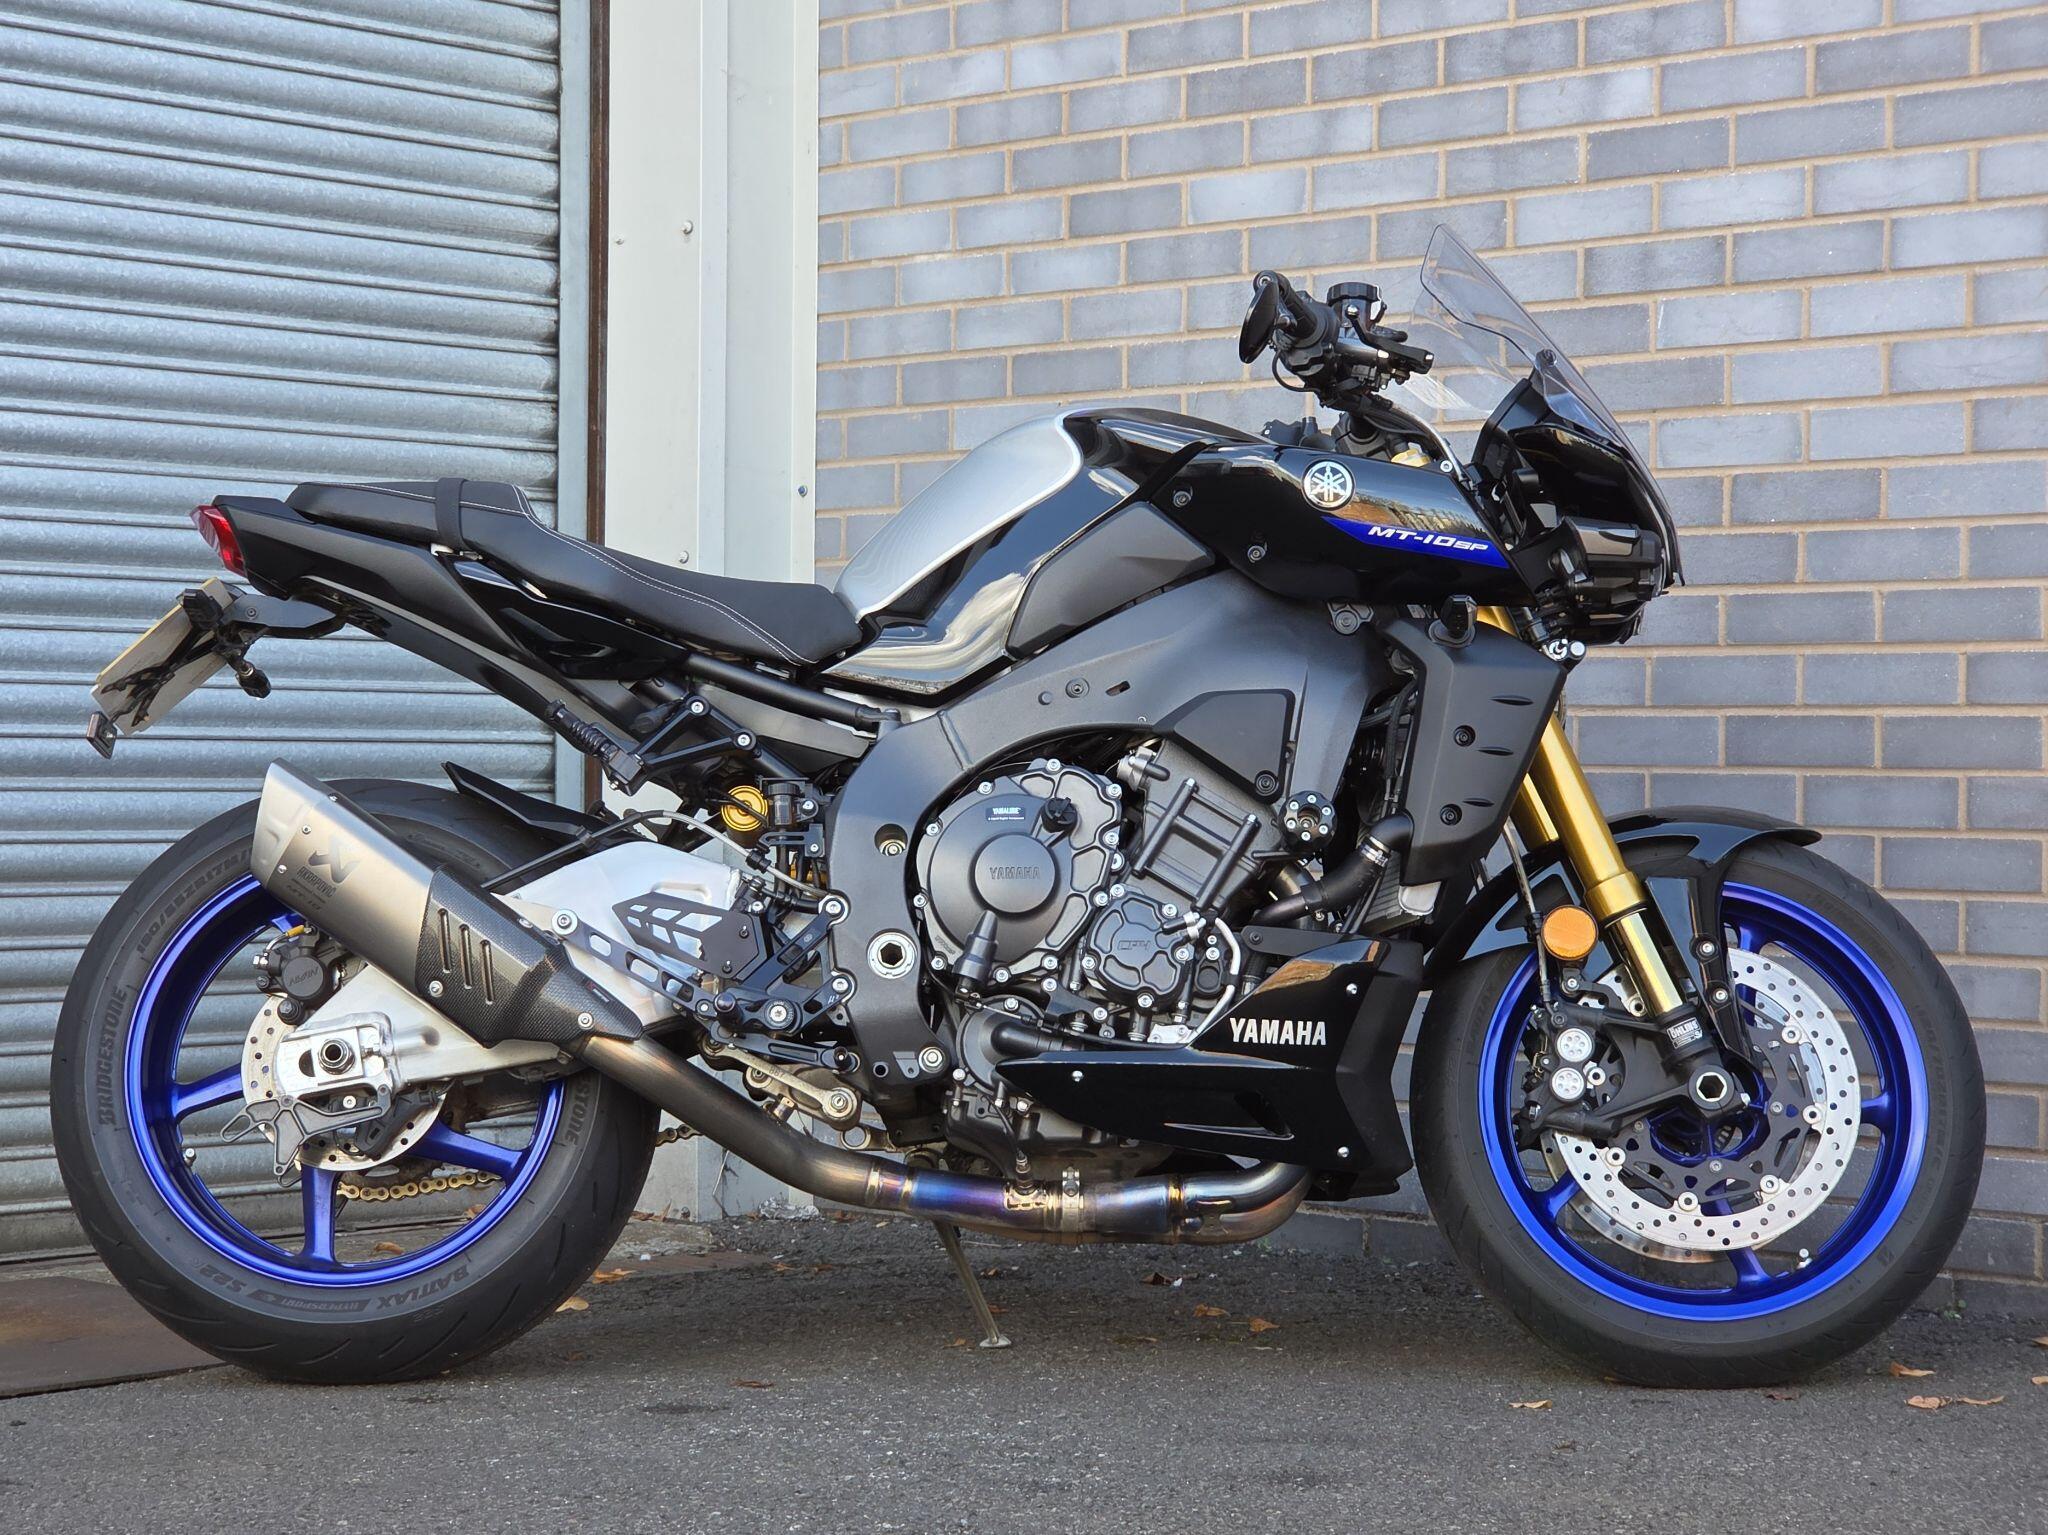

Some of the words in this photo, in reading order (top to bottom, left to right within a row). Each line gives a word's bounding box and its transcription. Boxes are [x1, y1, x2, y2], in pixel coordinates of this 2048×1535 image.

[1368, 526, 1489, 551] MT-10SP
[989, 866, 1040, 880] YAMAHA
[1229, 1017, 1327, 1046] YAMAHA
[98, 984, 129, 1126] BRIDGESTONE
